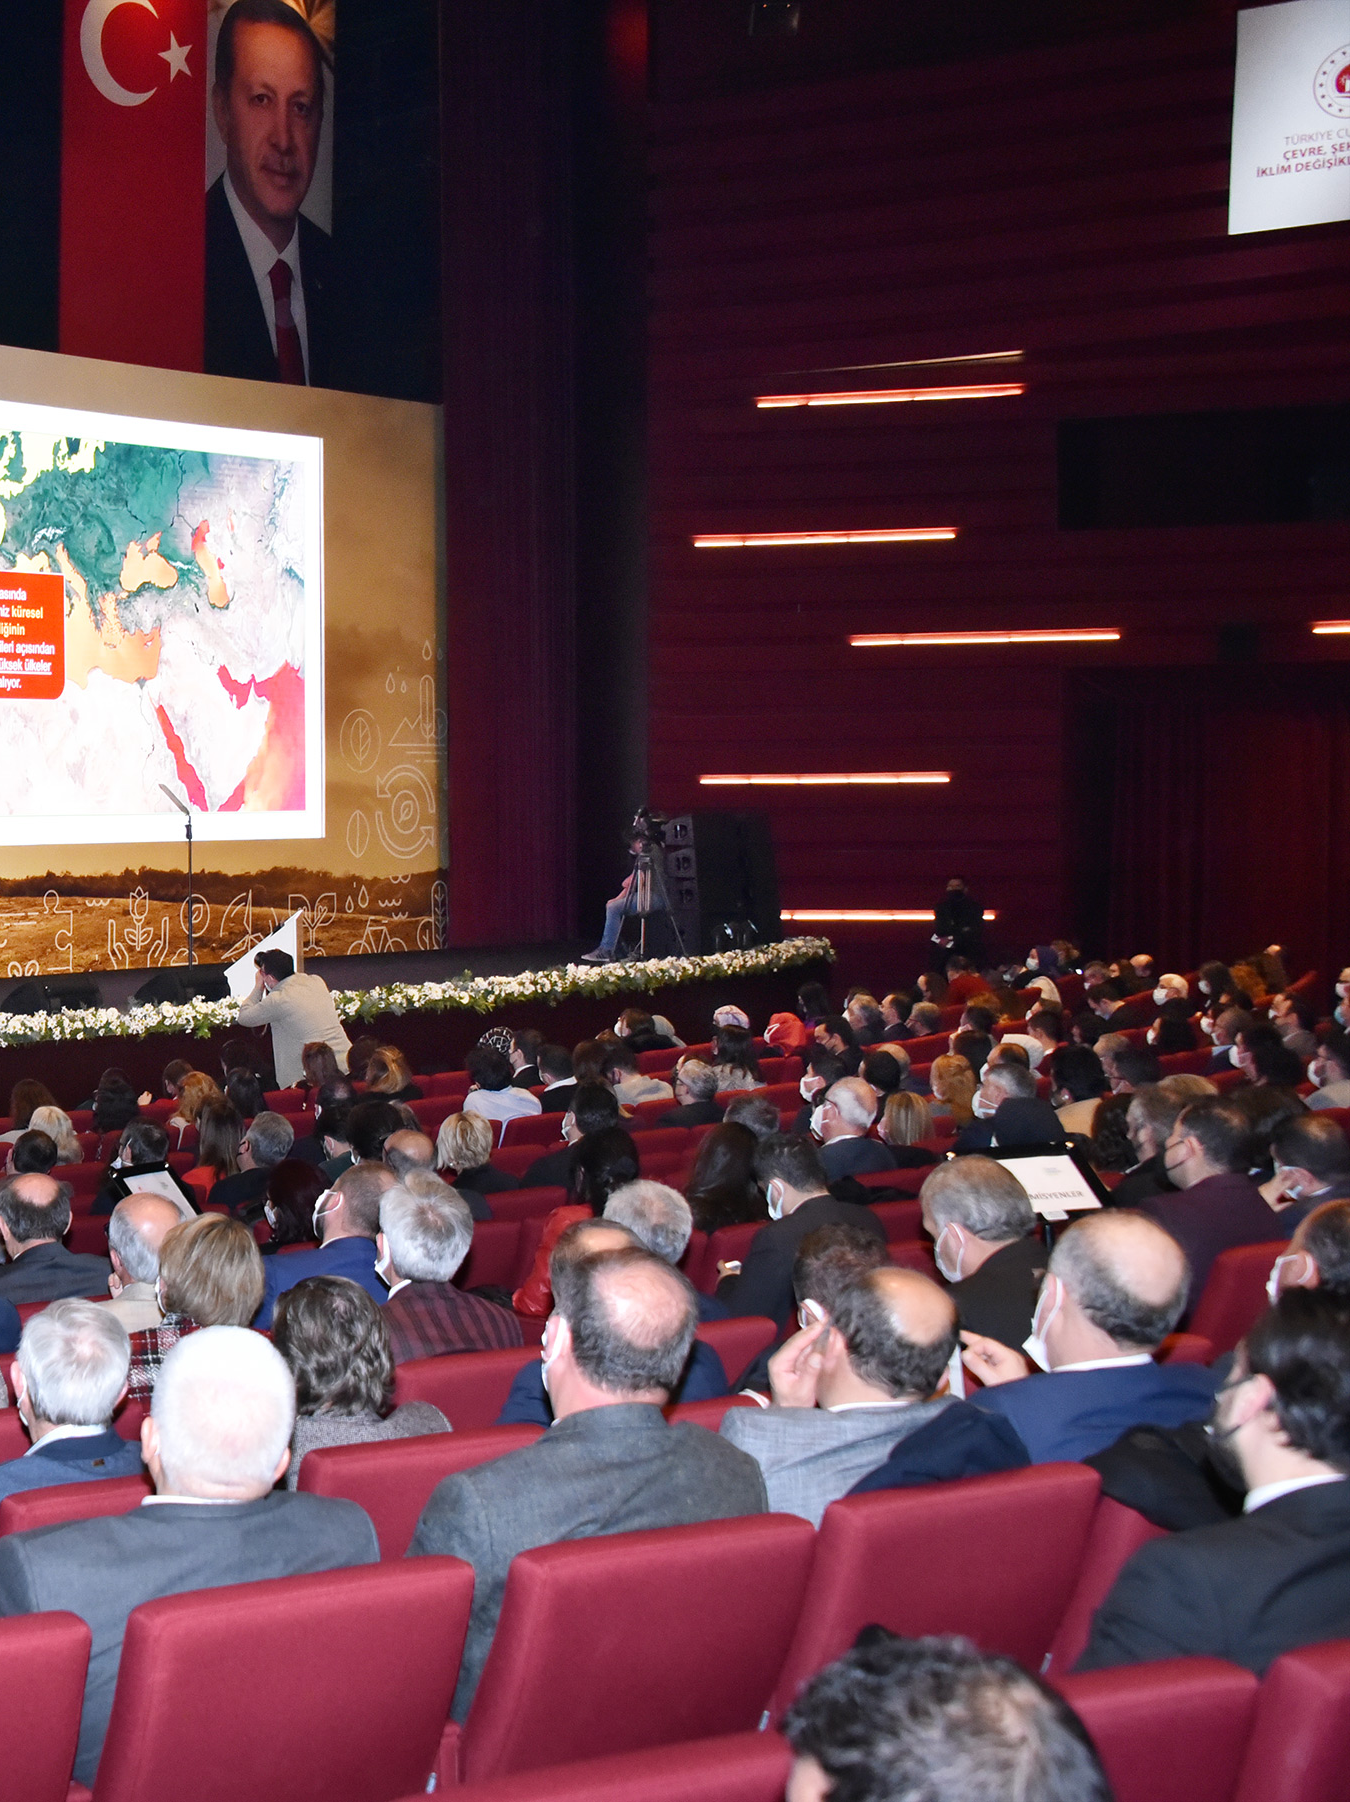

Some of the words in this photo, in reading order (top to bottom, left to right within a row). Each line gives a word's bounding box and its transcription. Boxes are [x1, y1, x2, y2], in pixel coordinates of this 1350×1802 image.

[1283, 146, 1326, 162] ÇEVRE,
[1257, 164, 1291, 178] İKLİM
[12, 605, 44, 619] küresel
[16, 642, 55, 656] açısından
[24, 658, 52, 672] ülkeler
